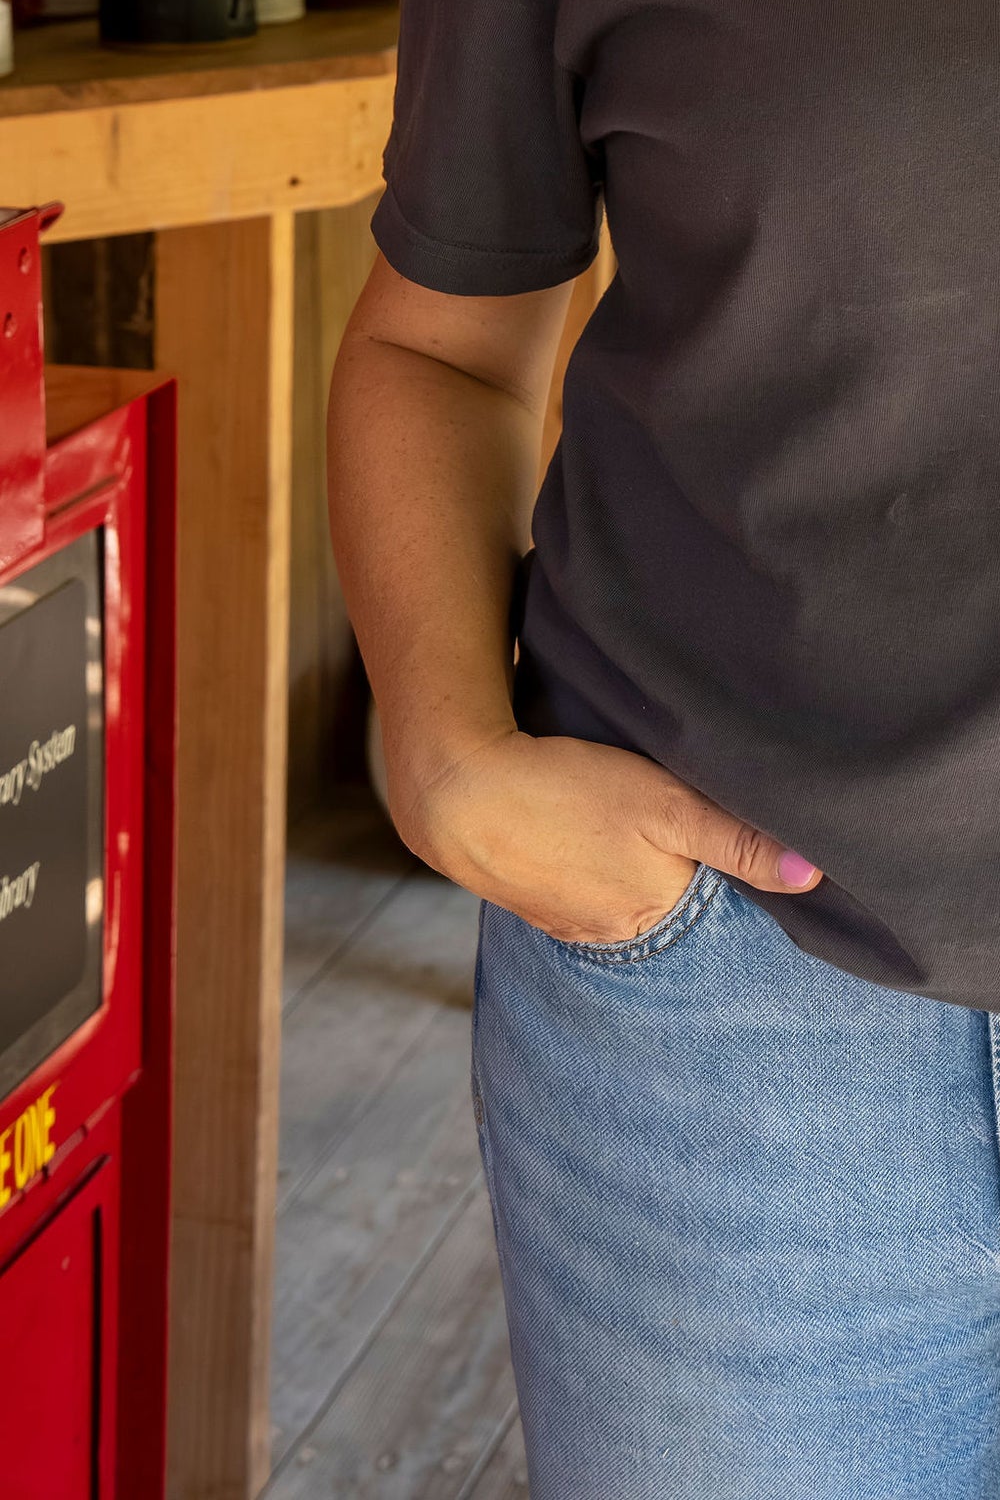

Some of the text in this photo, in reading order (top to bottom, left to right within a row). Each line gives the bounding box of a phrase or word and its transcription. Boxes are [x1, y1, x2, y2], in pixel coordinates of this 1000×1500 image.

[0, 723, 77, 807] ary System
[0, 861, 40, 922] brary
[14, 1082, 58, 1190] ONE
